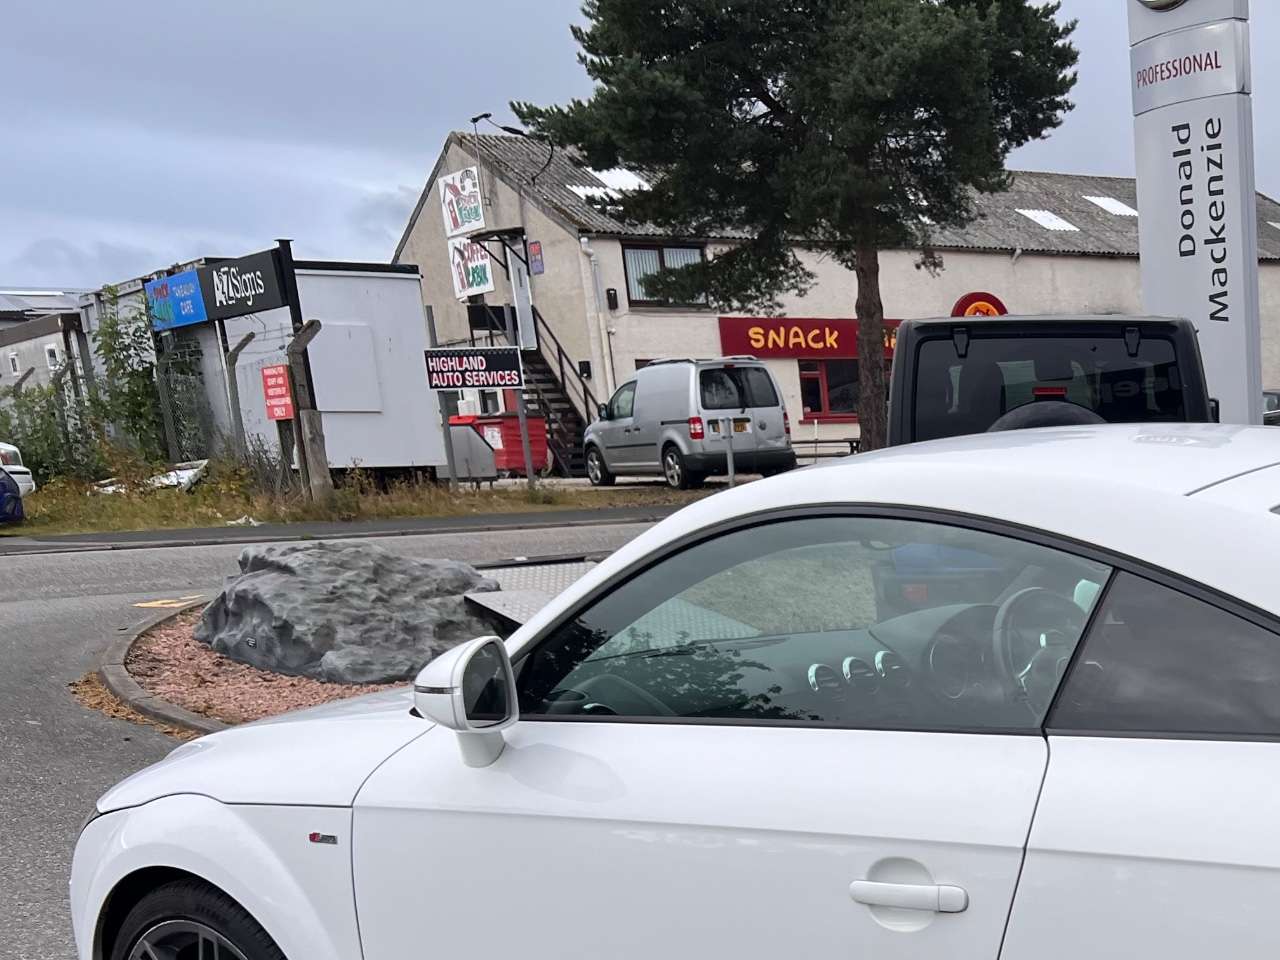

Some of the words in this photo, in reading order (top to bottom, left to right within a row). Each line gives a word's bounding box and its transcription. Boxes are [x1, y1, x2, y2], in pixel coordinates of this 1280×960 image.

[1136, 51, 1222, 88] PROFESSIONAL
[1171, 122, 1196, 257] Donald
[1200, 117, 1230, 322] Mackenzie
[748, 326, 839, 349] SNACK
[428, 356, 487, 372] HIGHLAND
[432, 372, 462, 387] AUTO
[465, 371, 520, 386] SERVICES
